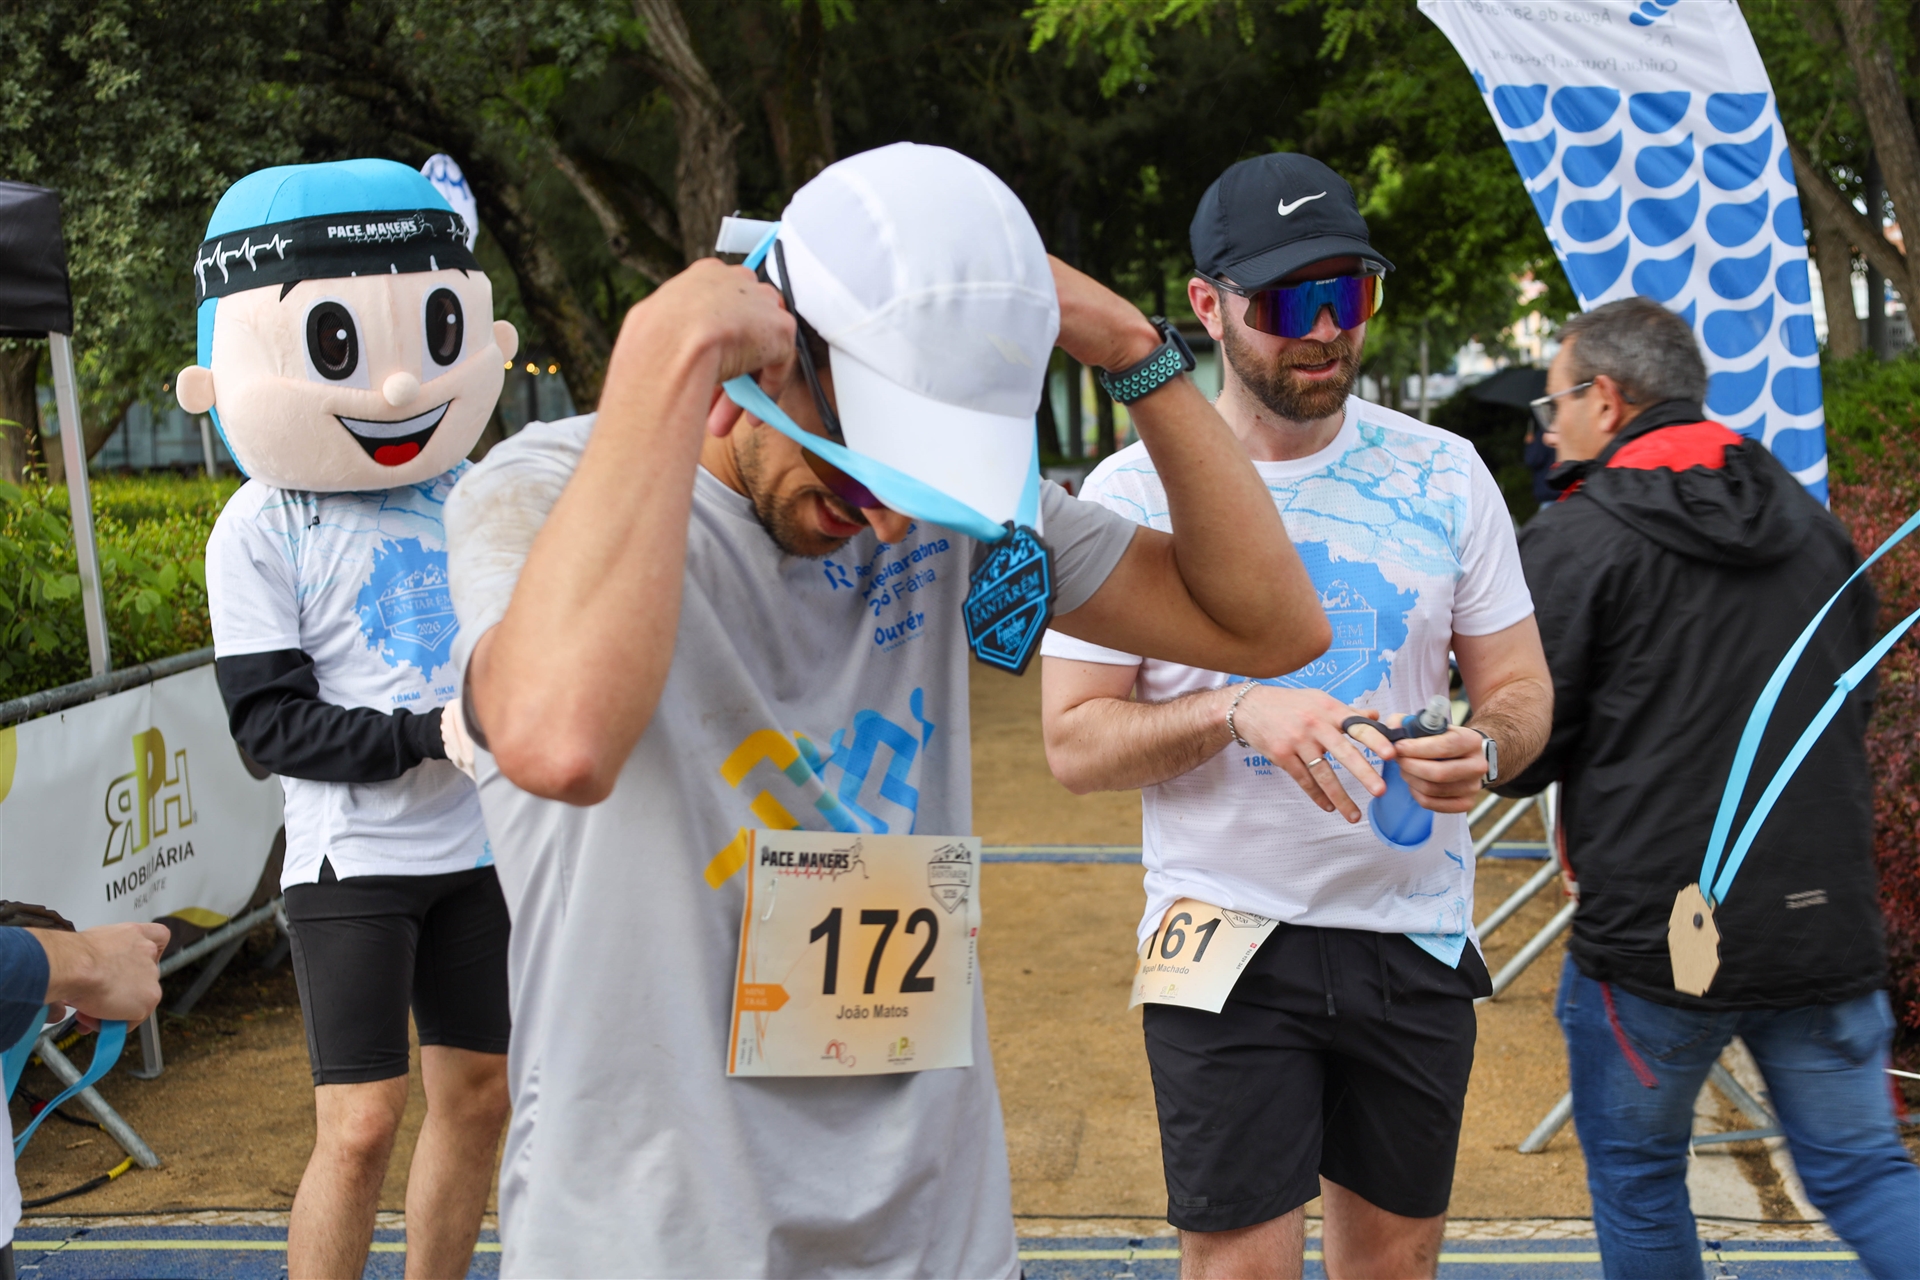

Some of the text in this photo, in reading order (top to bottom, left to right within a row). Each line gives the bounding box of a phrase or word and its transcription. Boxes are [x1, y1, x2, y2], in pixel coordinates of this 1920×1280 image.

[327, 220, 418, 239] PACE MAKERS
[971, 570, 1041, 629] SANTARÉM
[1341, 638, 1365, 647] TRAIL
[1295, 659, 1338, 678] 2026
[1243, 755, 1273, 768] 18K
[760, 850, 849, 869] PACE MAKERS
[1147, 912, 1222, 963] 161
[809, 907, 939, 995] 172
[1158, 963, 1190, 975] Machado
[836, 1004, 909, 1019] João Matos
